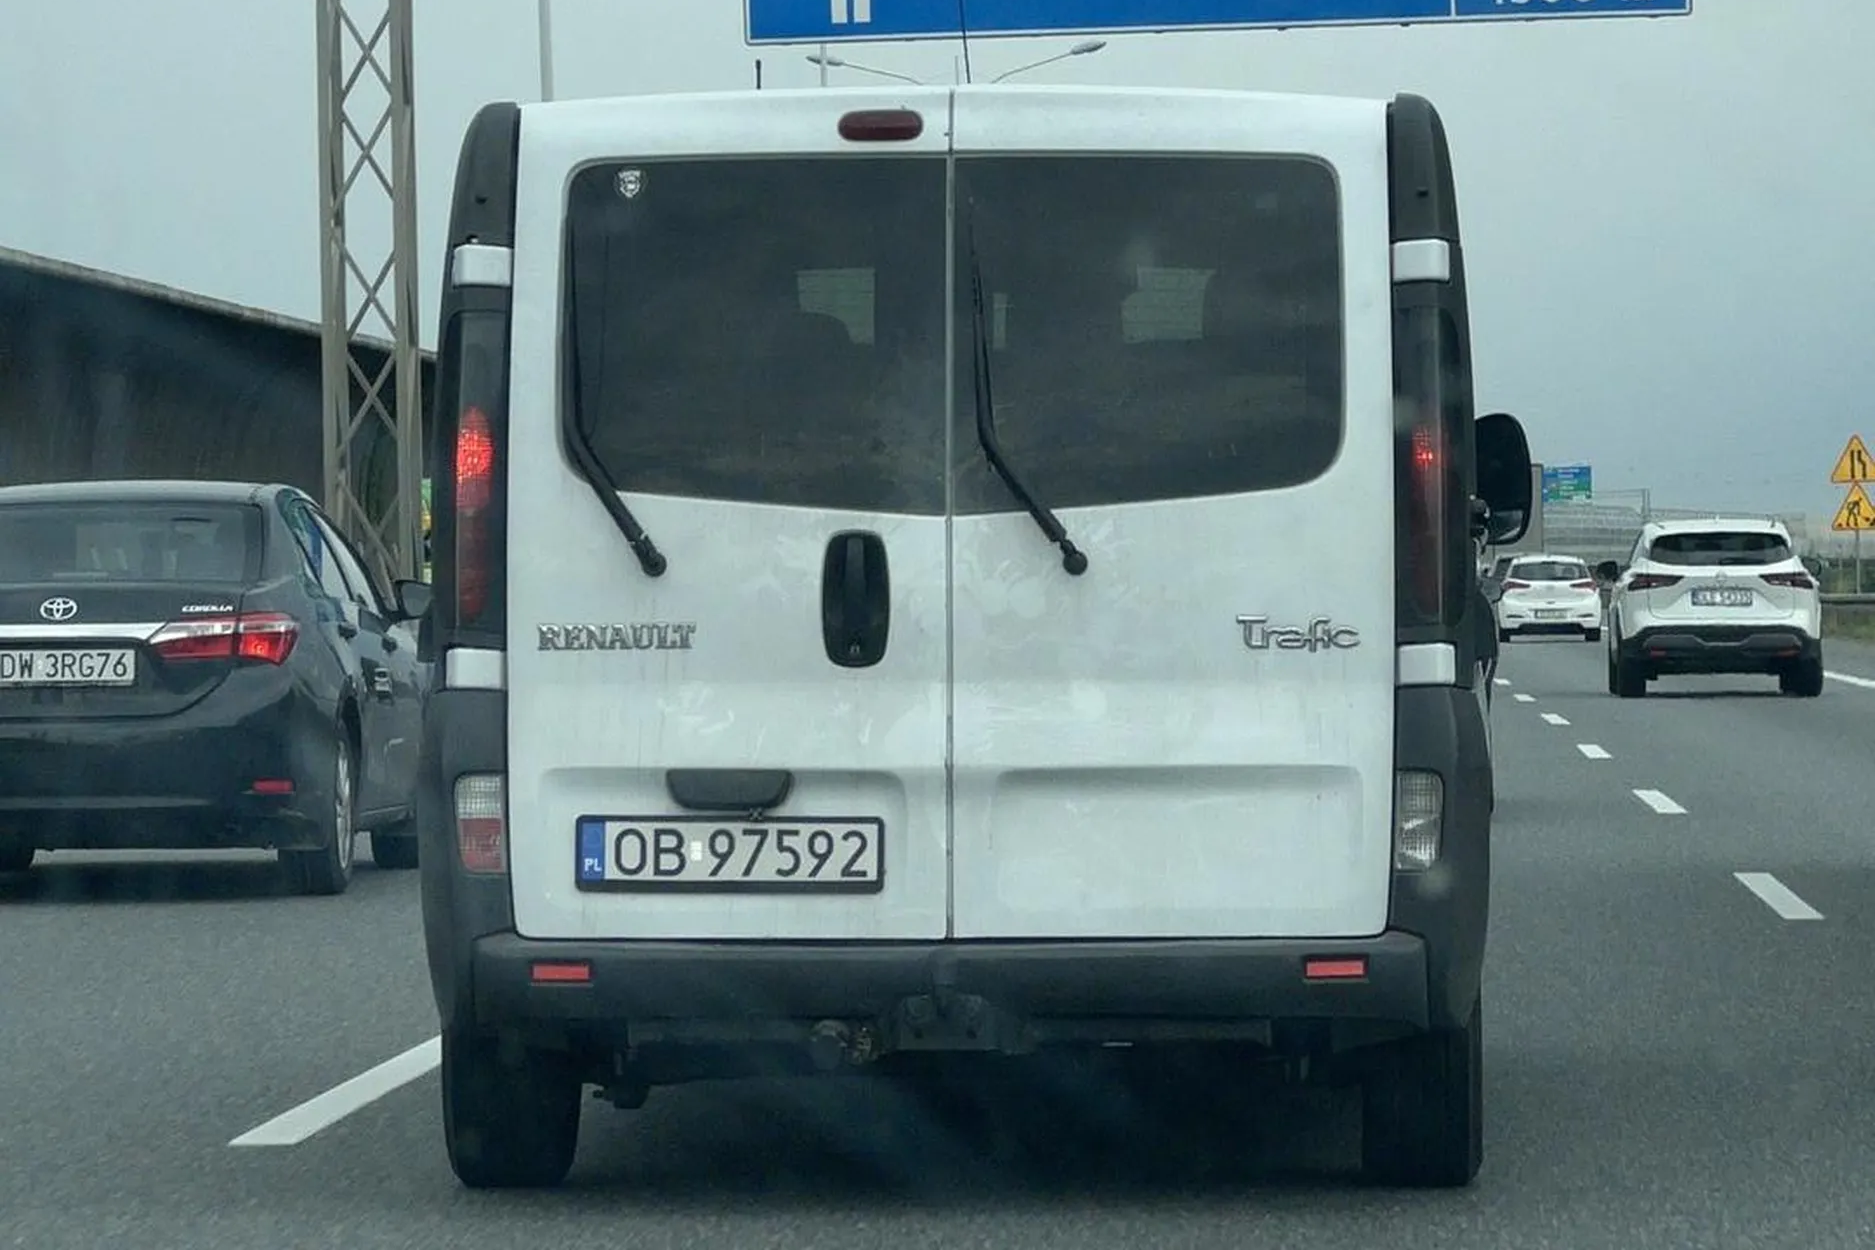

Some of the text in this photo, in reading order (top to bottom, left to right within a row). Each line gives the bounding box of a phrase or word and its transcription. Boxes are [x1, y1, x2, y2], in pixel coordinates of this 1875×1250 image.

[538, 623, 697, 651] RENAULT
[1236, 615, 1360, 653] Trafic
[1, 652, 127, 678] DW 3RG76
[584, 858, 601, 872] PL
[614, 828, 868, 877] OB 97592
